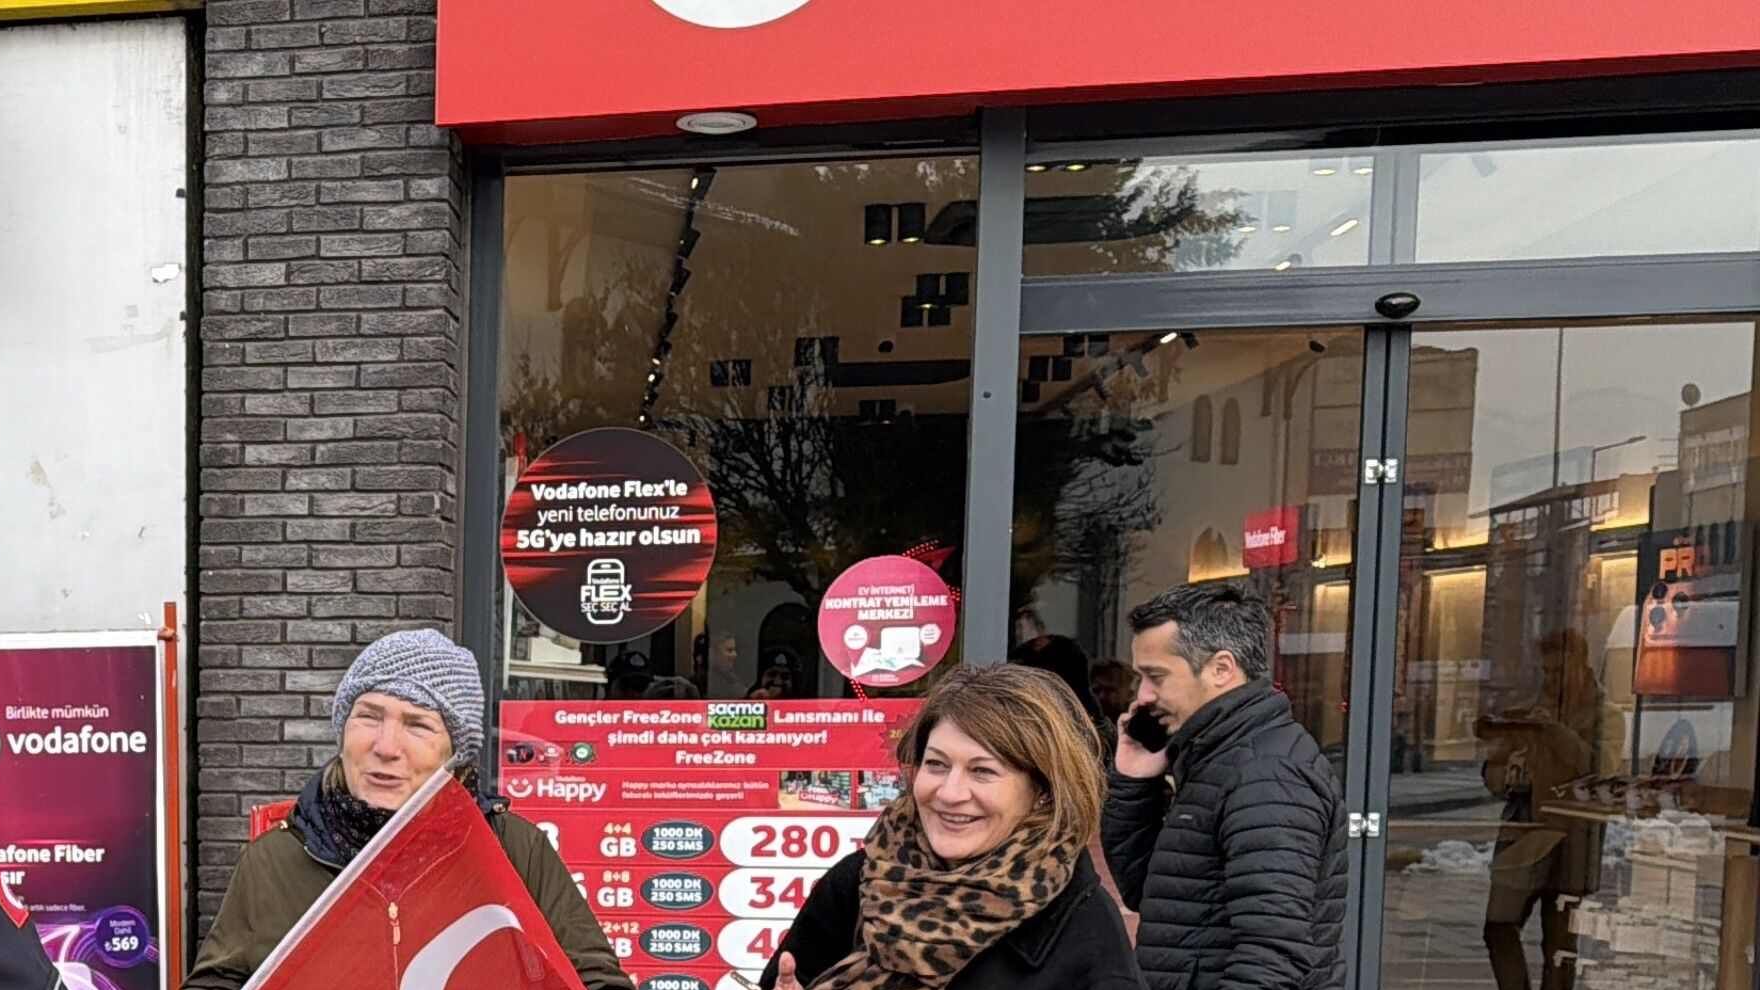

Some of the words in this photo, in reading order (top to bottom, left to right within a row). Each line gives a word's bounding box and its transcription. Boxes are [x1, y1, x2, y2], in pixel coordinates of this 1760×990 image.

[531, 481, 620, 500] Vodafone
[623, 480, 688, 498] Flex'le
[537, 506, 573, 526] yeni
[577, 504, 679, 522] telefonunuz
[516, 529, 576, 552] 5G'ye
[580, 528, 636, 547] hazır
[639, 526, 701, 545] olsun
[581, 585, 632, 602] FLEX
[619, 602, 632, 612] AL
[825, 596, 883, 609] KONTRAT
[5, 704, 49, 720] Birlikte
[51, 704, 109, 719] mümkün
[708, 703, 765, 716] saçma
[773, 709, 859, 724] Lansmanı
[555, 710, 620, 727] Gençler
[623, 710, 702, 724] FreeZone
[708, 714, 765, 729] kazan
[7, 725, 147, 754] vodafone
[607, 730, 654, 747] şimdi
[657, 731, 698, 744] daha
[701, 731, 733, 747] çok
[735, 730, 828, 747] kazanıyor!
[675, 750, 756, 765] FreeZone
[537, 778, 606, 802] Happy
[603, 823, 632, 835] 4+4
[653, 827, 683, 837] 1000
[685, 827, 703, 837] DK
[600, 837, 637, 857] GB
[652, 841, 674, 850] 250
[677, 841, 704, 850] SMS
[750, 825, 840, 858] 280
[54, 845, 105, 862] Fiber
[603, 871, 630, 882] 8+8
[651, 879, 681, 889] 1000
[684, 879, 702, 889] DK
[597, 887, 634, 908] GB
[651, 892, 673, 902] 250
[676, 892, 702, 902] SMS
[748, 877, 818, 909] 34
[599, 922, 639, 934] 2+12
[650, 930, 680, 940] 1000
[683, 930, 701, 940] DK
[650, 943, 672, 953] 250
[674, 943, 701, 953] SMS
[649, 980, 679, 990] 1000
[682, 980, 700, 990] DK
